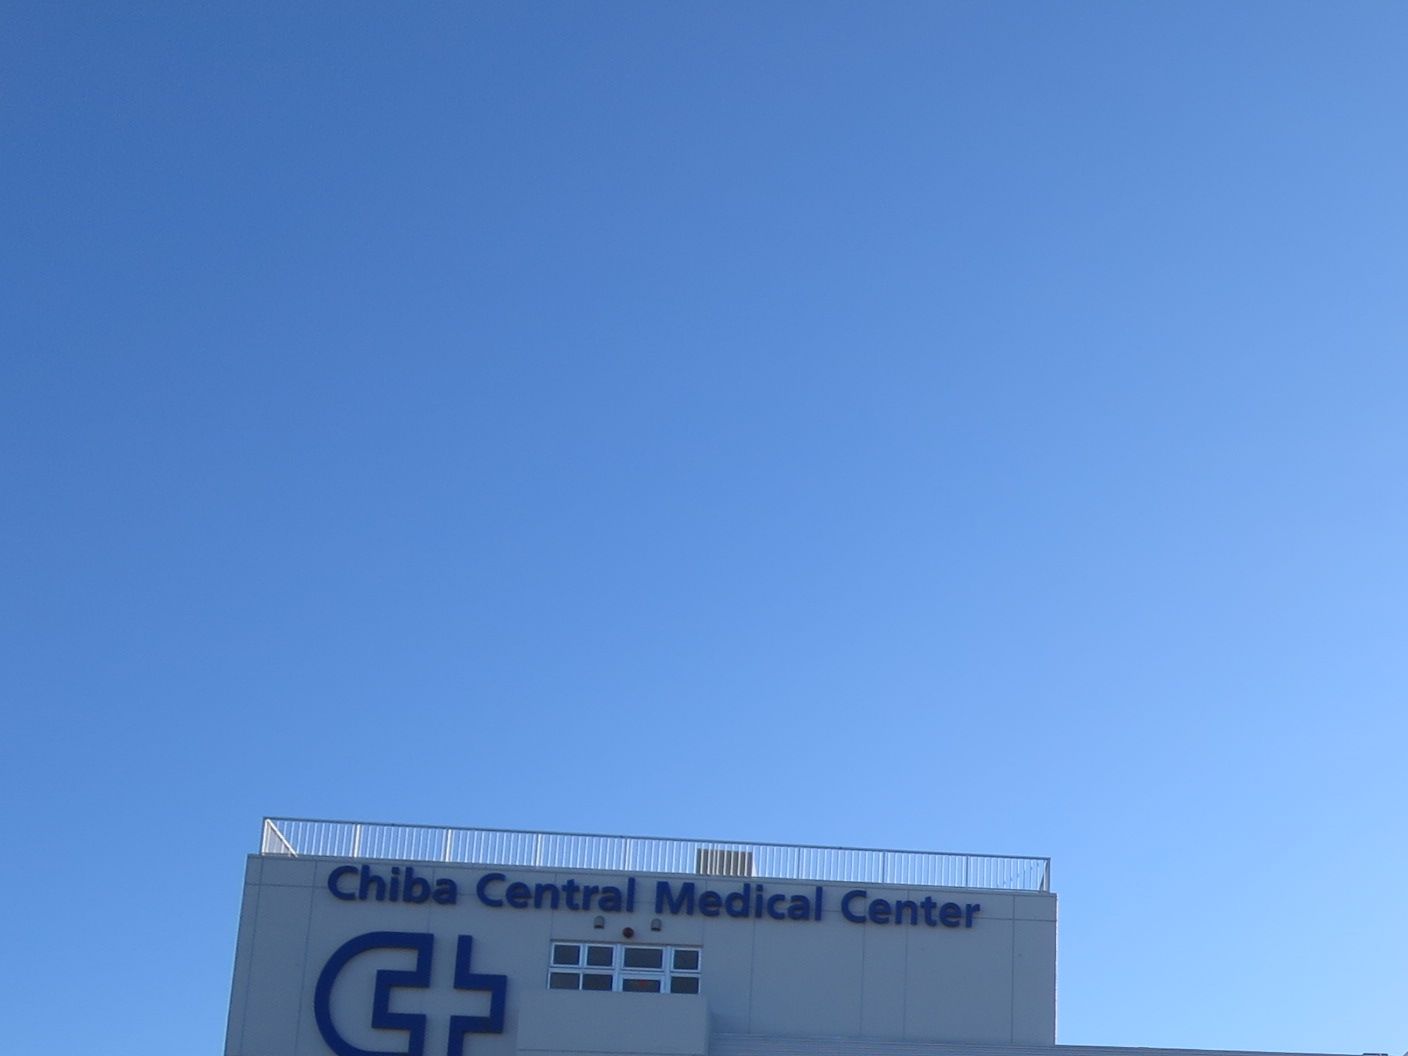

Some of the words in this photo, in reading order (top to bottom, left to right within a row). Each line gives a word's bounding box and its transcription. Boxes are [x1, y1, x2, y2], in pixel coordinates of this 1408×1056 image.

[327, 864, 457, 904] Chiba
[476, 871, 636, 914] Central
[655, 880, 824, 922] Medical
[841, 888, 981, 929] Center
